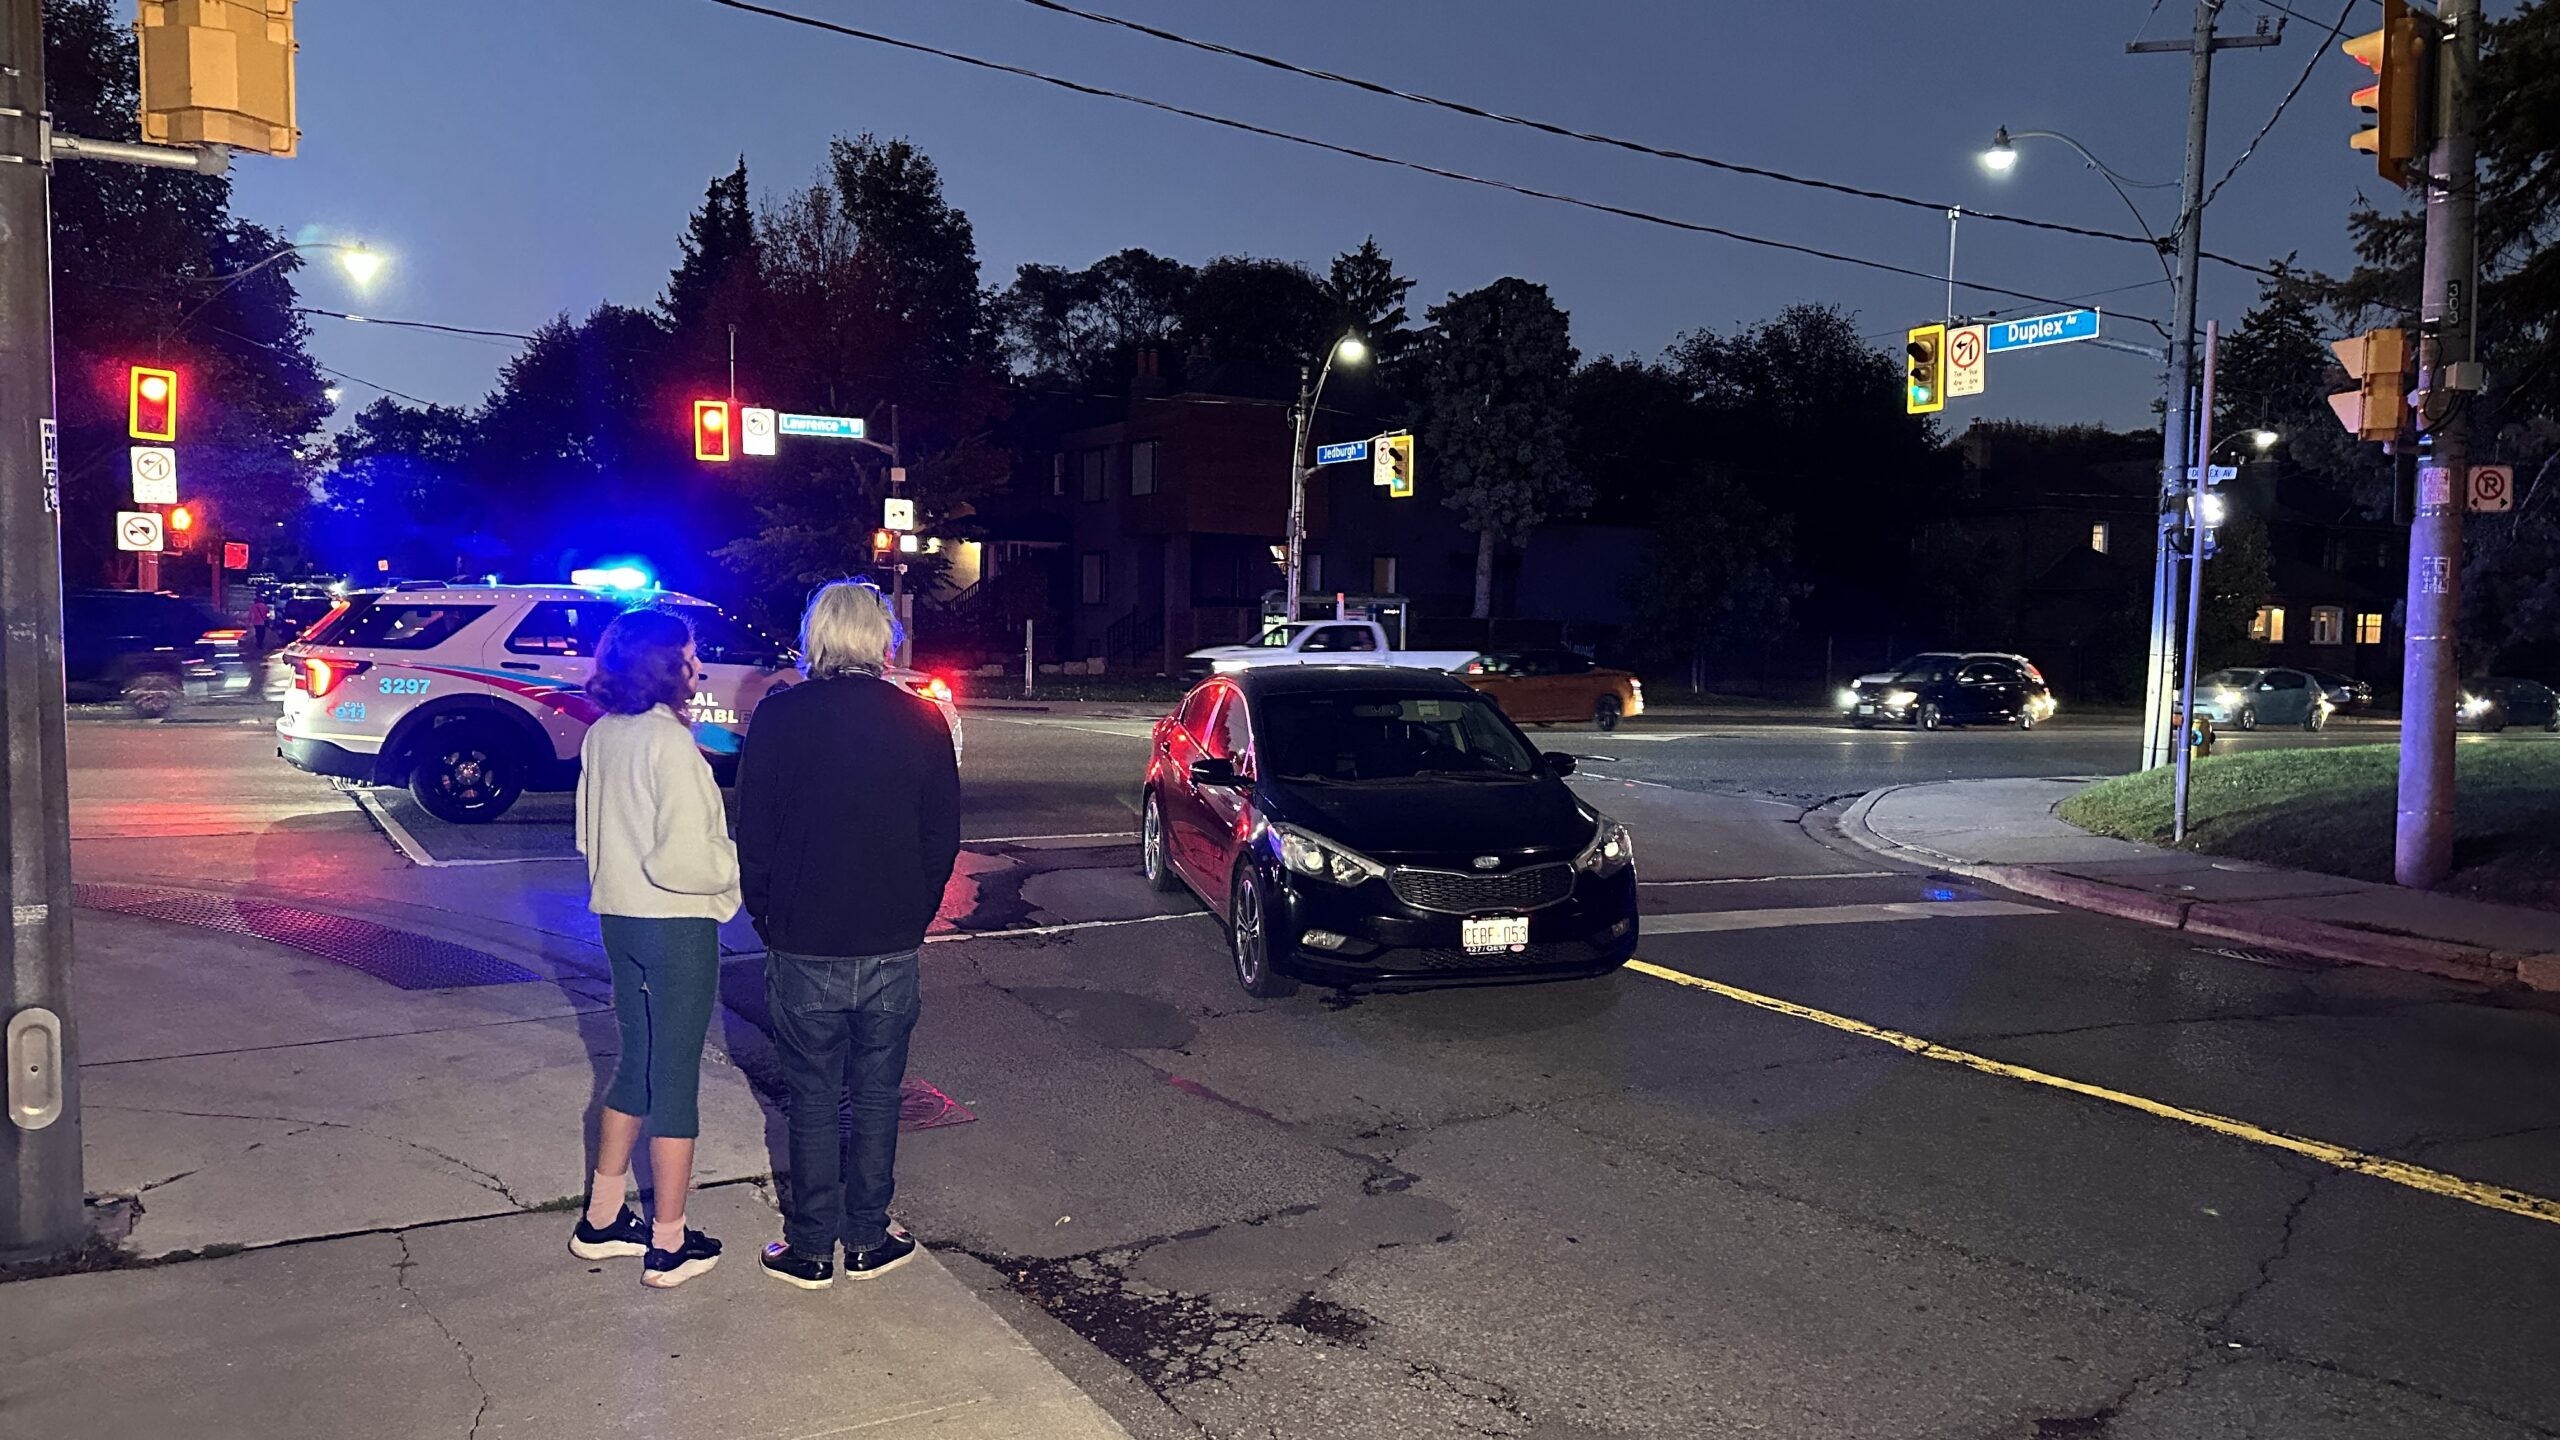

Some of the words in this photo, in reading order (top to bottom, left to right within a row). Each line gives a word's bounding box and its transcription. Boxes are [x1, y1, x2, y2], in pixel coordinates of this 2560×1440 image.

[2449, 283, 2459, 324] 303
[2008, 319, 2063, 344] Duplex
[2066, 314, 2078, 326] Av
[783, 416, 839, 432] Lawrence
[1323, 444, 1357, 459] Jedburgh
[2222, 469, 2232, 478] AV
[379, 677, 431, 694] 3297
